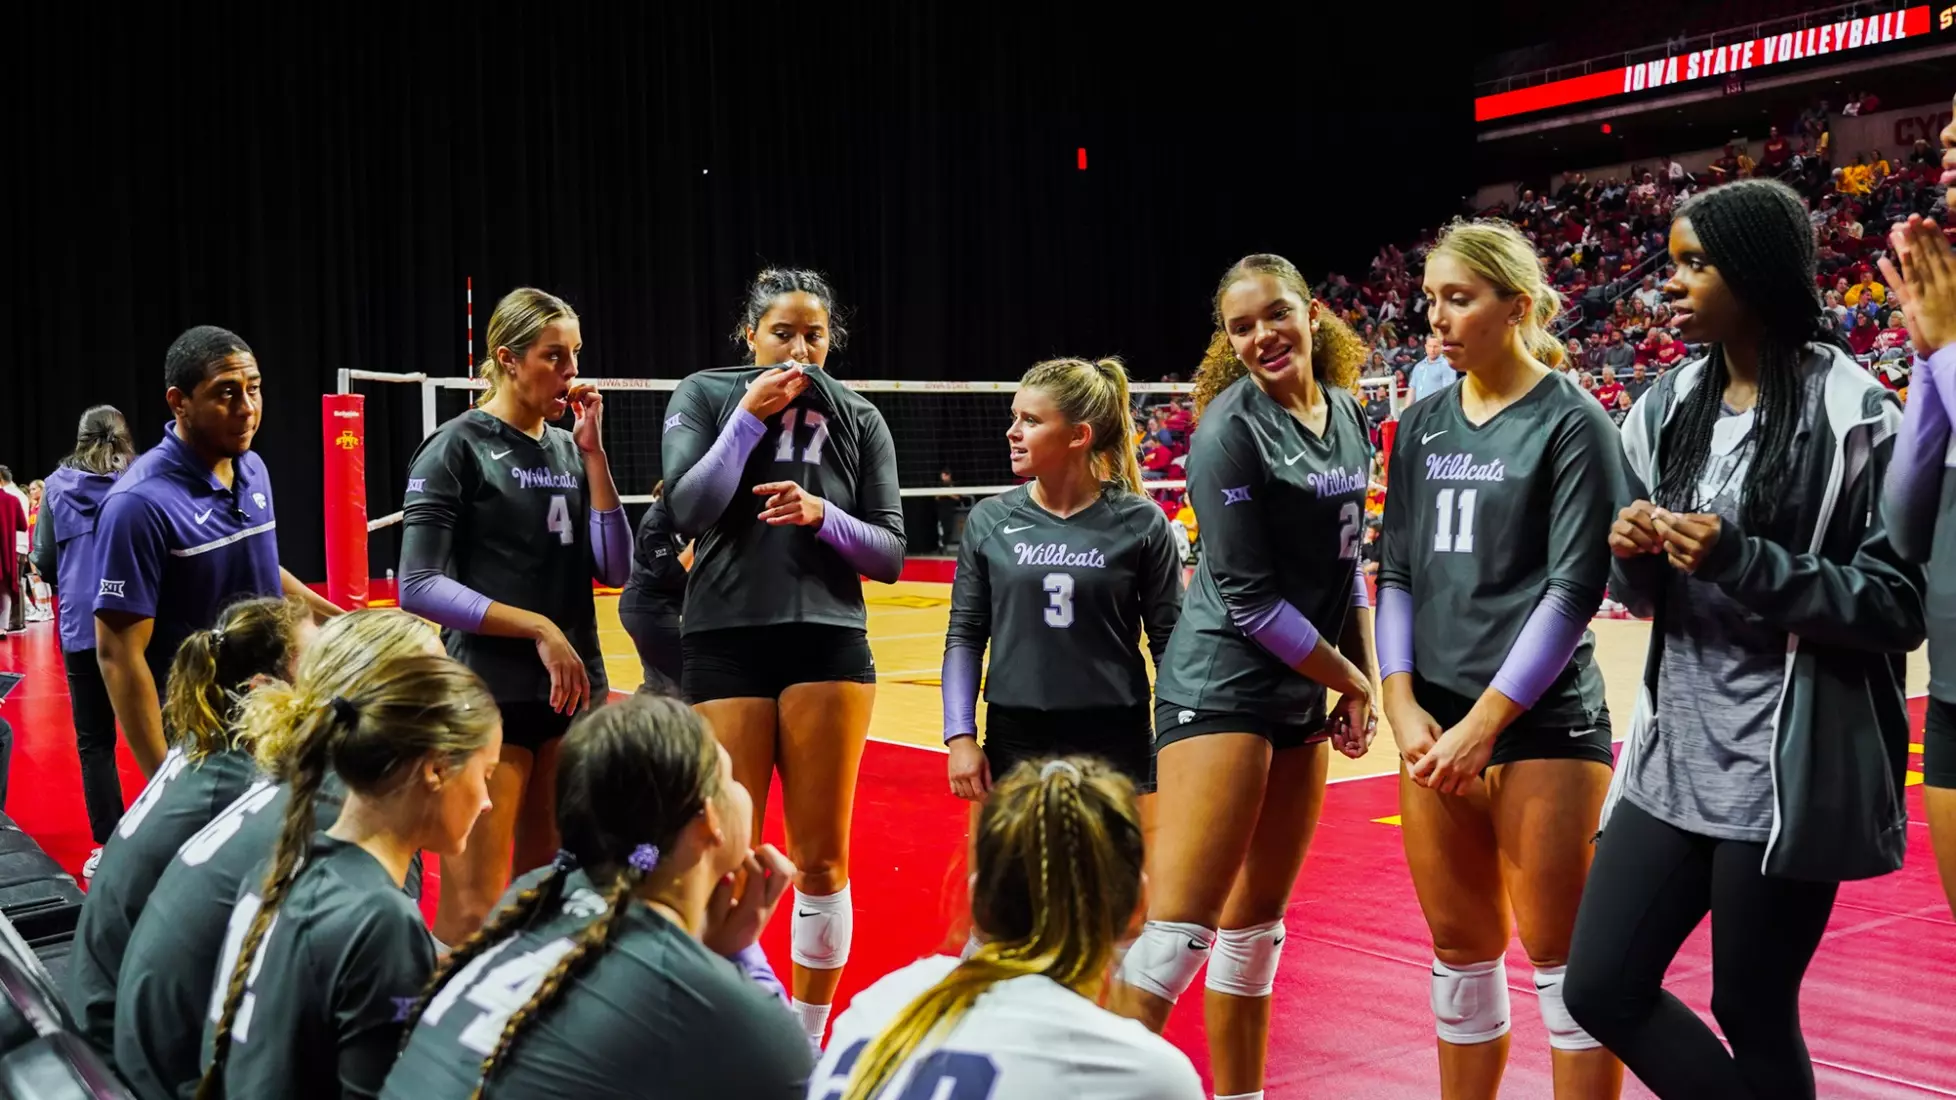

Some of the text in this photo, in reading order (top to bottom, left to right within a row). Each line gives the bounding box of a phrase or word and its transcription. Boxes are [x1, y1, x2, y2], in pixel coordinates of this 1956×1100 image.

[1624, 10, 1906, 93] IOWA STATE VOLLEYBALL
[775, 407, 829, 466] 17
[512, 467, 578, 489] Wildcats
[1308, 466, 1367, 499] Wildcat
[1426, 453, 1505, 481] Wildcats
[547, 494, 573, 546] 4
[1434, 488, 1477, 553] 11
[1014, 542, 1106, 568] Wildcats
[1043, 572, 1075, 628] 3
[422, 931, 578, 1057] 14
